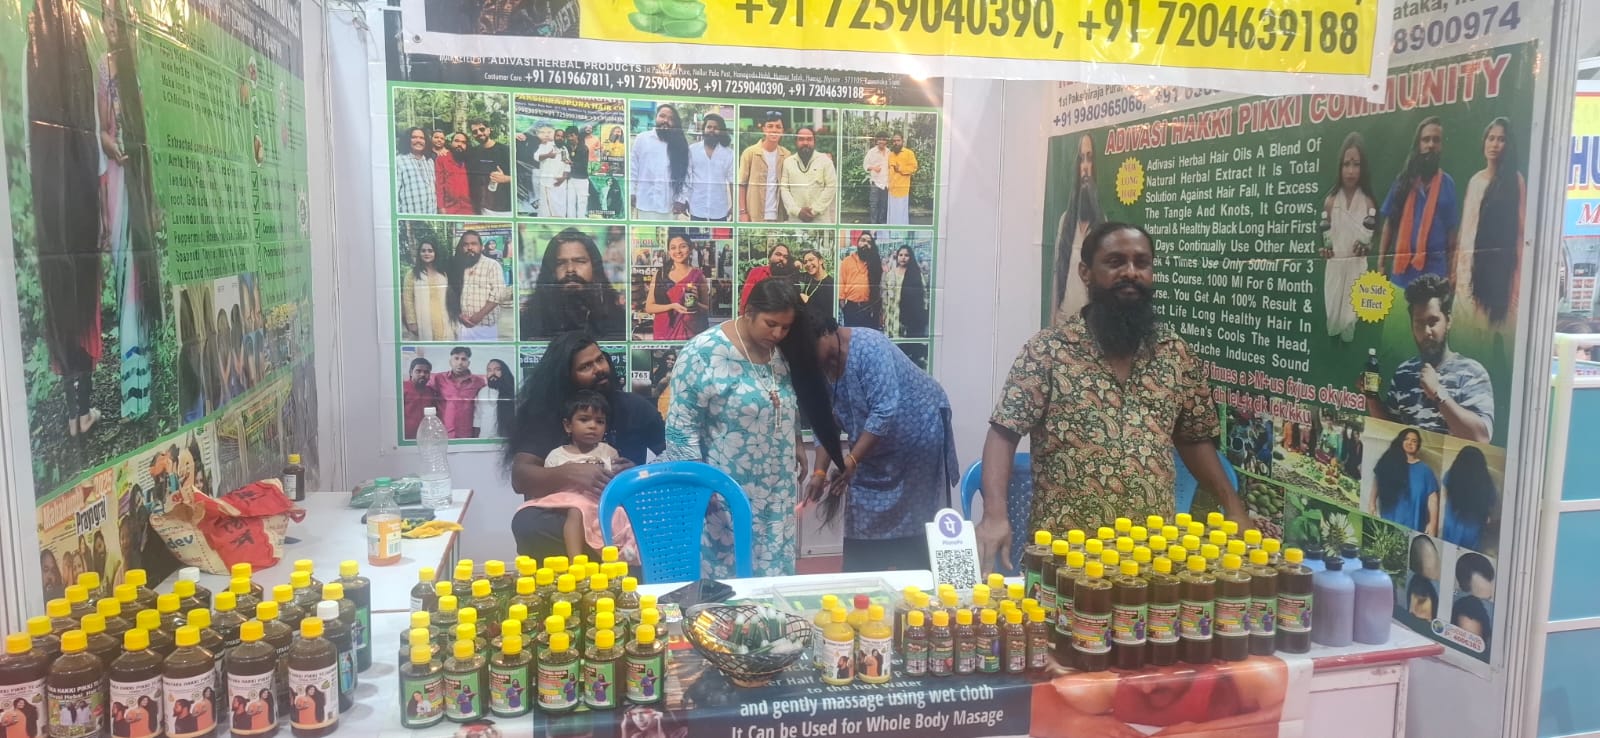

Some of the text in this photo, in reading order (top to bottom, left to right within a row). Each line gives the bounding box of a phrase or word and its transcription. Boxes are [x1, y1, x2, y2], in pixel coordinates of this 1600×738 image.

[824, 0, 1065, 49] 7259040390,
[1078, 0, 1141, 42] +91
[1155, 1, 1358, 54] 7204639188
[1393, 0, 1521, 54] 8900974
[491, 56, 534, 66] ADIVASI
[537, 58, 582, 69] HERBAL
[584, 62, 643, 73] PRODUCTS
[525, 70, 544, 83] +91
[549, 71, 614, 89] 7619667811,
[616, 75, 636, 89] +91
[639, 76, 700, 93] 7259040905,
[704, 79, 722, 92] +91
[726, 80, 785, 97] 7259040390,
[789, 84, 806, 96] +91
[809, 84, 864, 99] 7204639188
[1053, 111, 1072, 127] +91
[1105, 118, 1168, 154] ADIVASI
[1171, 106, 1233, 144] HAKKI
[1237, 94, 1302, 134] PIKKI
[1147, 137, 1322, 171] Adivasi Herbal Hair Oils A Blend Of
[1146, 158, 1319, 187] Natural Herbal Extract It Is Total
[1146, 181, 1319, 204] Solution Against Hair Fall, It Excess
[1145, 201, 1317, 220] The Tangle And Knots, It Grows,
[1144, 219, 1316, 237] Natural & Healthy Black Long Hair First
[1155, 239, 1315, 255] Days Continually Use Other Next
[1152, 257, 1162, 266] ek
[1165, 257, 1170, 266] 4
[1173, 256, 1197, 268] Times
[1202, 257, 1219, 269] Use
[1222, 257, 1244, 273] Only
[1283, 260, 1301, 273] For
[1306, 260, 1314, 273] 3
[1153, 272, 1169, 283] nths
[1172, 272, 1204, 286] Course.
[1207, 274, 1228, 287] 1000
[1247, 276, 1264, 289] For
[1267, 277, 1274, 291] 6
[1277, 278, 1313, 293] Month
[1360, 284, 1387, 296] No Side
[1174, 289, 1189, 301] You
[1194, 290, 1209, 303] Get
[1213, 292, 1225, 305] An
[1231, 293, 1256, 308] 100%
[1262, 295, 1297, 312] Result
[1303, 299, 1313, 313] &
[1361, 298, 1383, 309] Effect
[1170, 304, 1312, 333] Life Long Healthy Hair In
[1180, 322, 1212, 338] &Men's
[1217, 327, 1245, 343] Cools
[1251, 332, 1270, 347] The
[1277, 335, 1310, 355] Head,
[1226, 346, 1310, 372] Induces Sound
[166, 533, 194, 550] dev
[807, 687, 823, 695] to
[827, 684, 853, 693] the
[740, 684, 994, 719] and gently massage using wet cloth
[731, 709, 1004, 738] It Can be Used for Whole Body Masage
